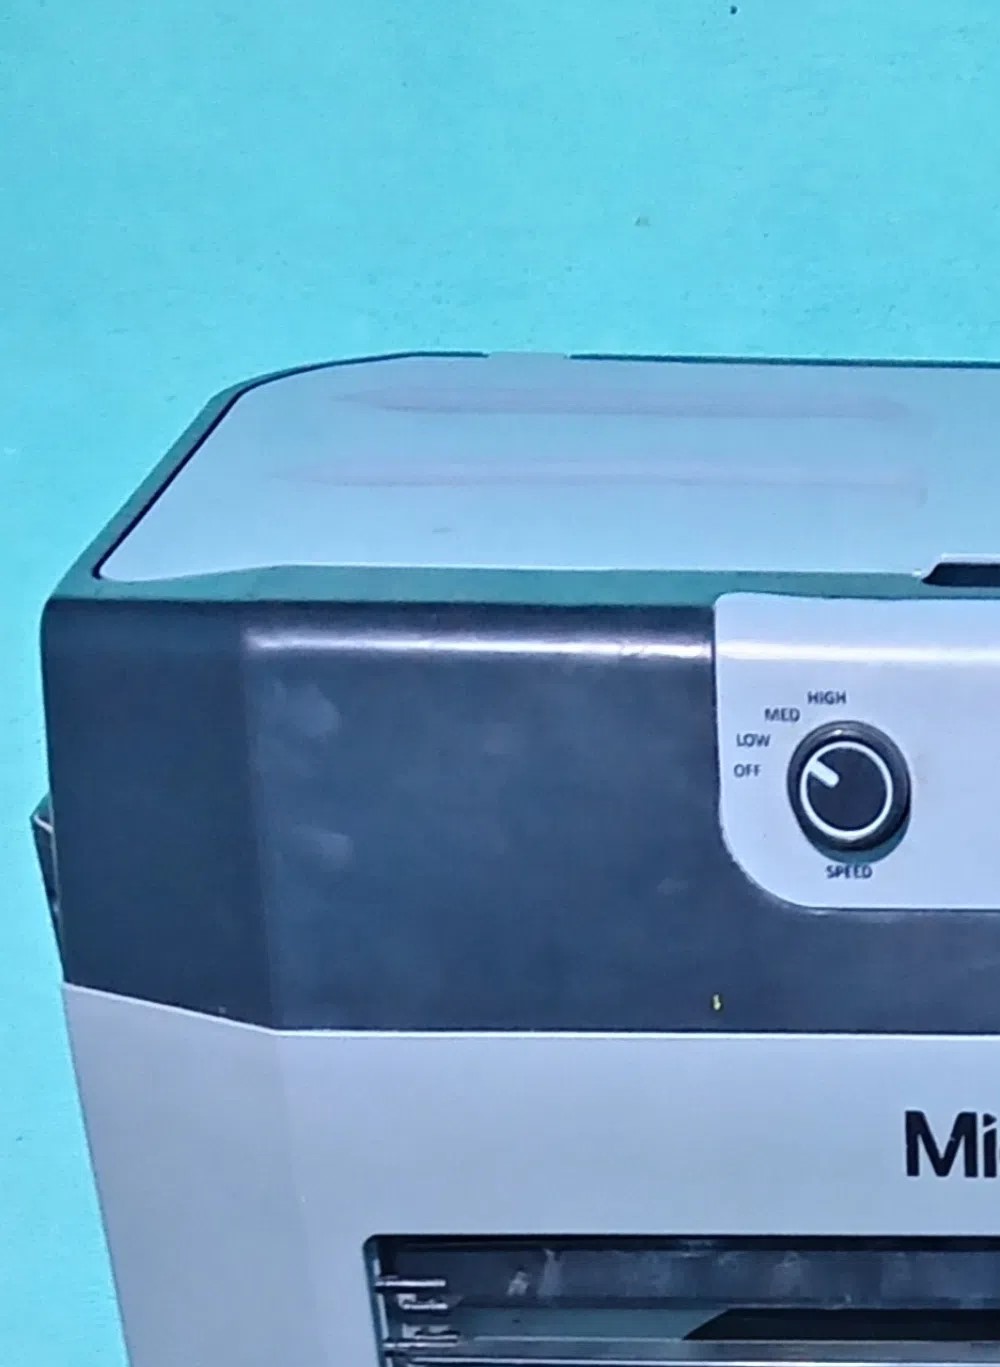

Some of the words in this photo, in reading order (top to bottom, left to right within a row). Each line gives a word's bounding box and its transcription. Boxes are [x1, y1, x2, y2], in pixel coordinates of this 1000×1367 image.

[807, 690, 847, 705] HIGH
[764, 707, 801, 722] MED
[736, 733, 771, 748] LOW
[733, 763, 762, 778] OFF
[825, 864, 873, 879] SPEED
